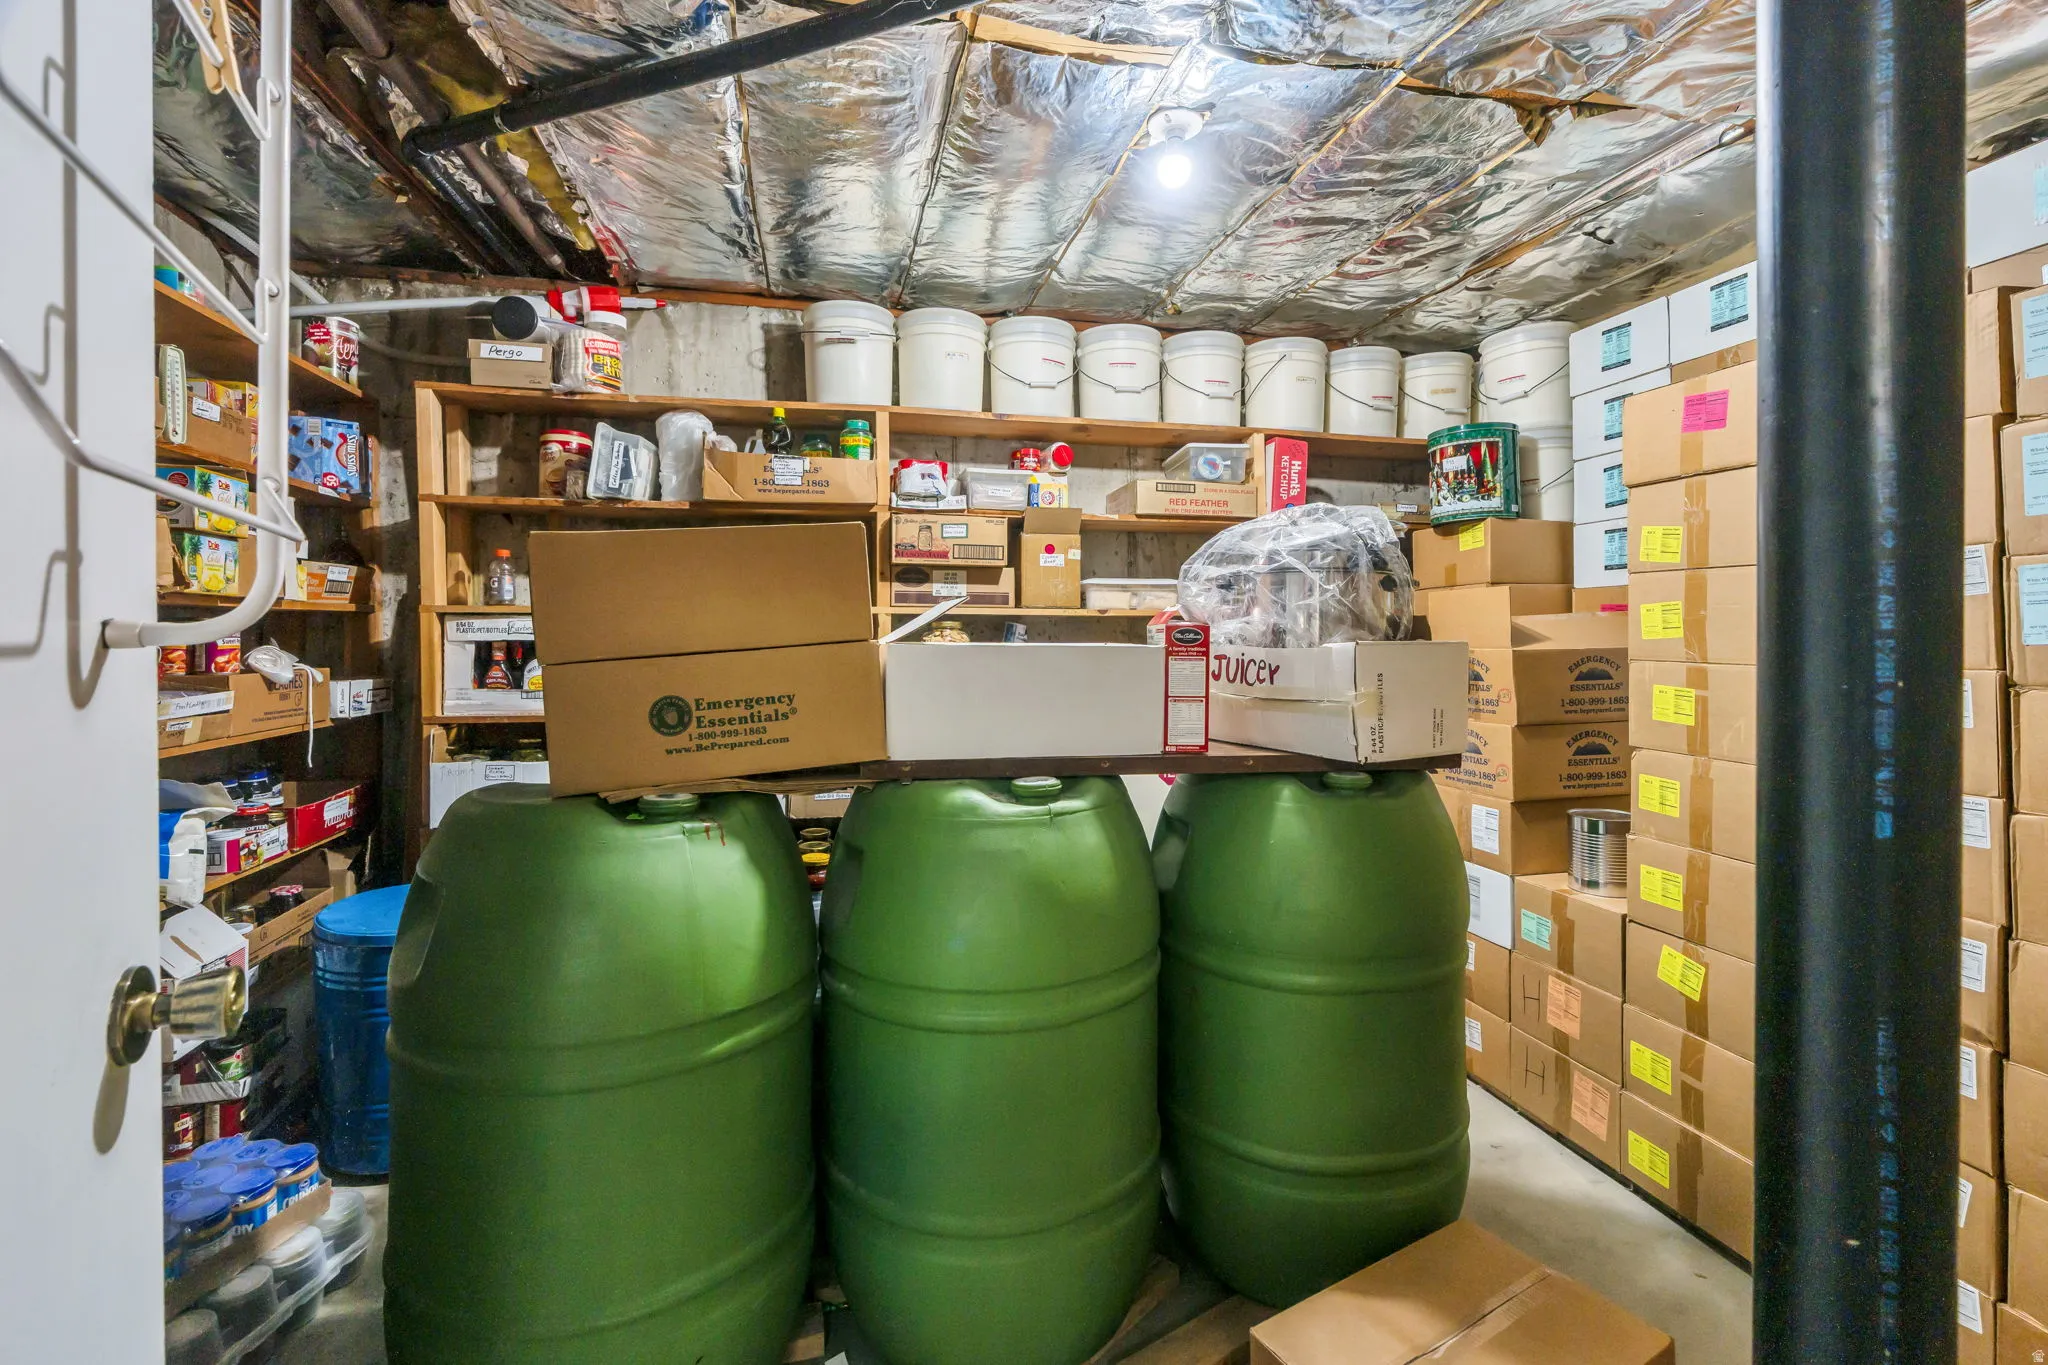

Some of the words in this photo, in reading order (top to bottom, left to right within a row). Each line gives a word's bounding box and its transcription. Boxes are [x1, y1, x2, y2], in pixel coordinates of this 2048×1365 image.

[488, 345, 523, 358] Pergo
[1281, 455, 1290, 500] KETCHUP
[1291, 460, 1301, 497] Hunt's
[1169, 498, 1187, 506] RED
[1190, 499, 1229, 508] FEATHER
[1567, 655, 1622, 673] EMERGENCY
[694, 693, 796, 711] Emergency
[1560, 696, 1629, 707] 1-800-999-1863
[688, 726, 767, 741] 1-800-999-1863
[1565, 729, 1619, 748] EMERGENCY
[665, 736, 790, 755] www.BePrepared.com
[1559, 771, 1627, 782] 1-800-999-1863
[1522, 974, 1541, 1022] H
[1524, 1045, 1545, 1095] H
